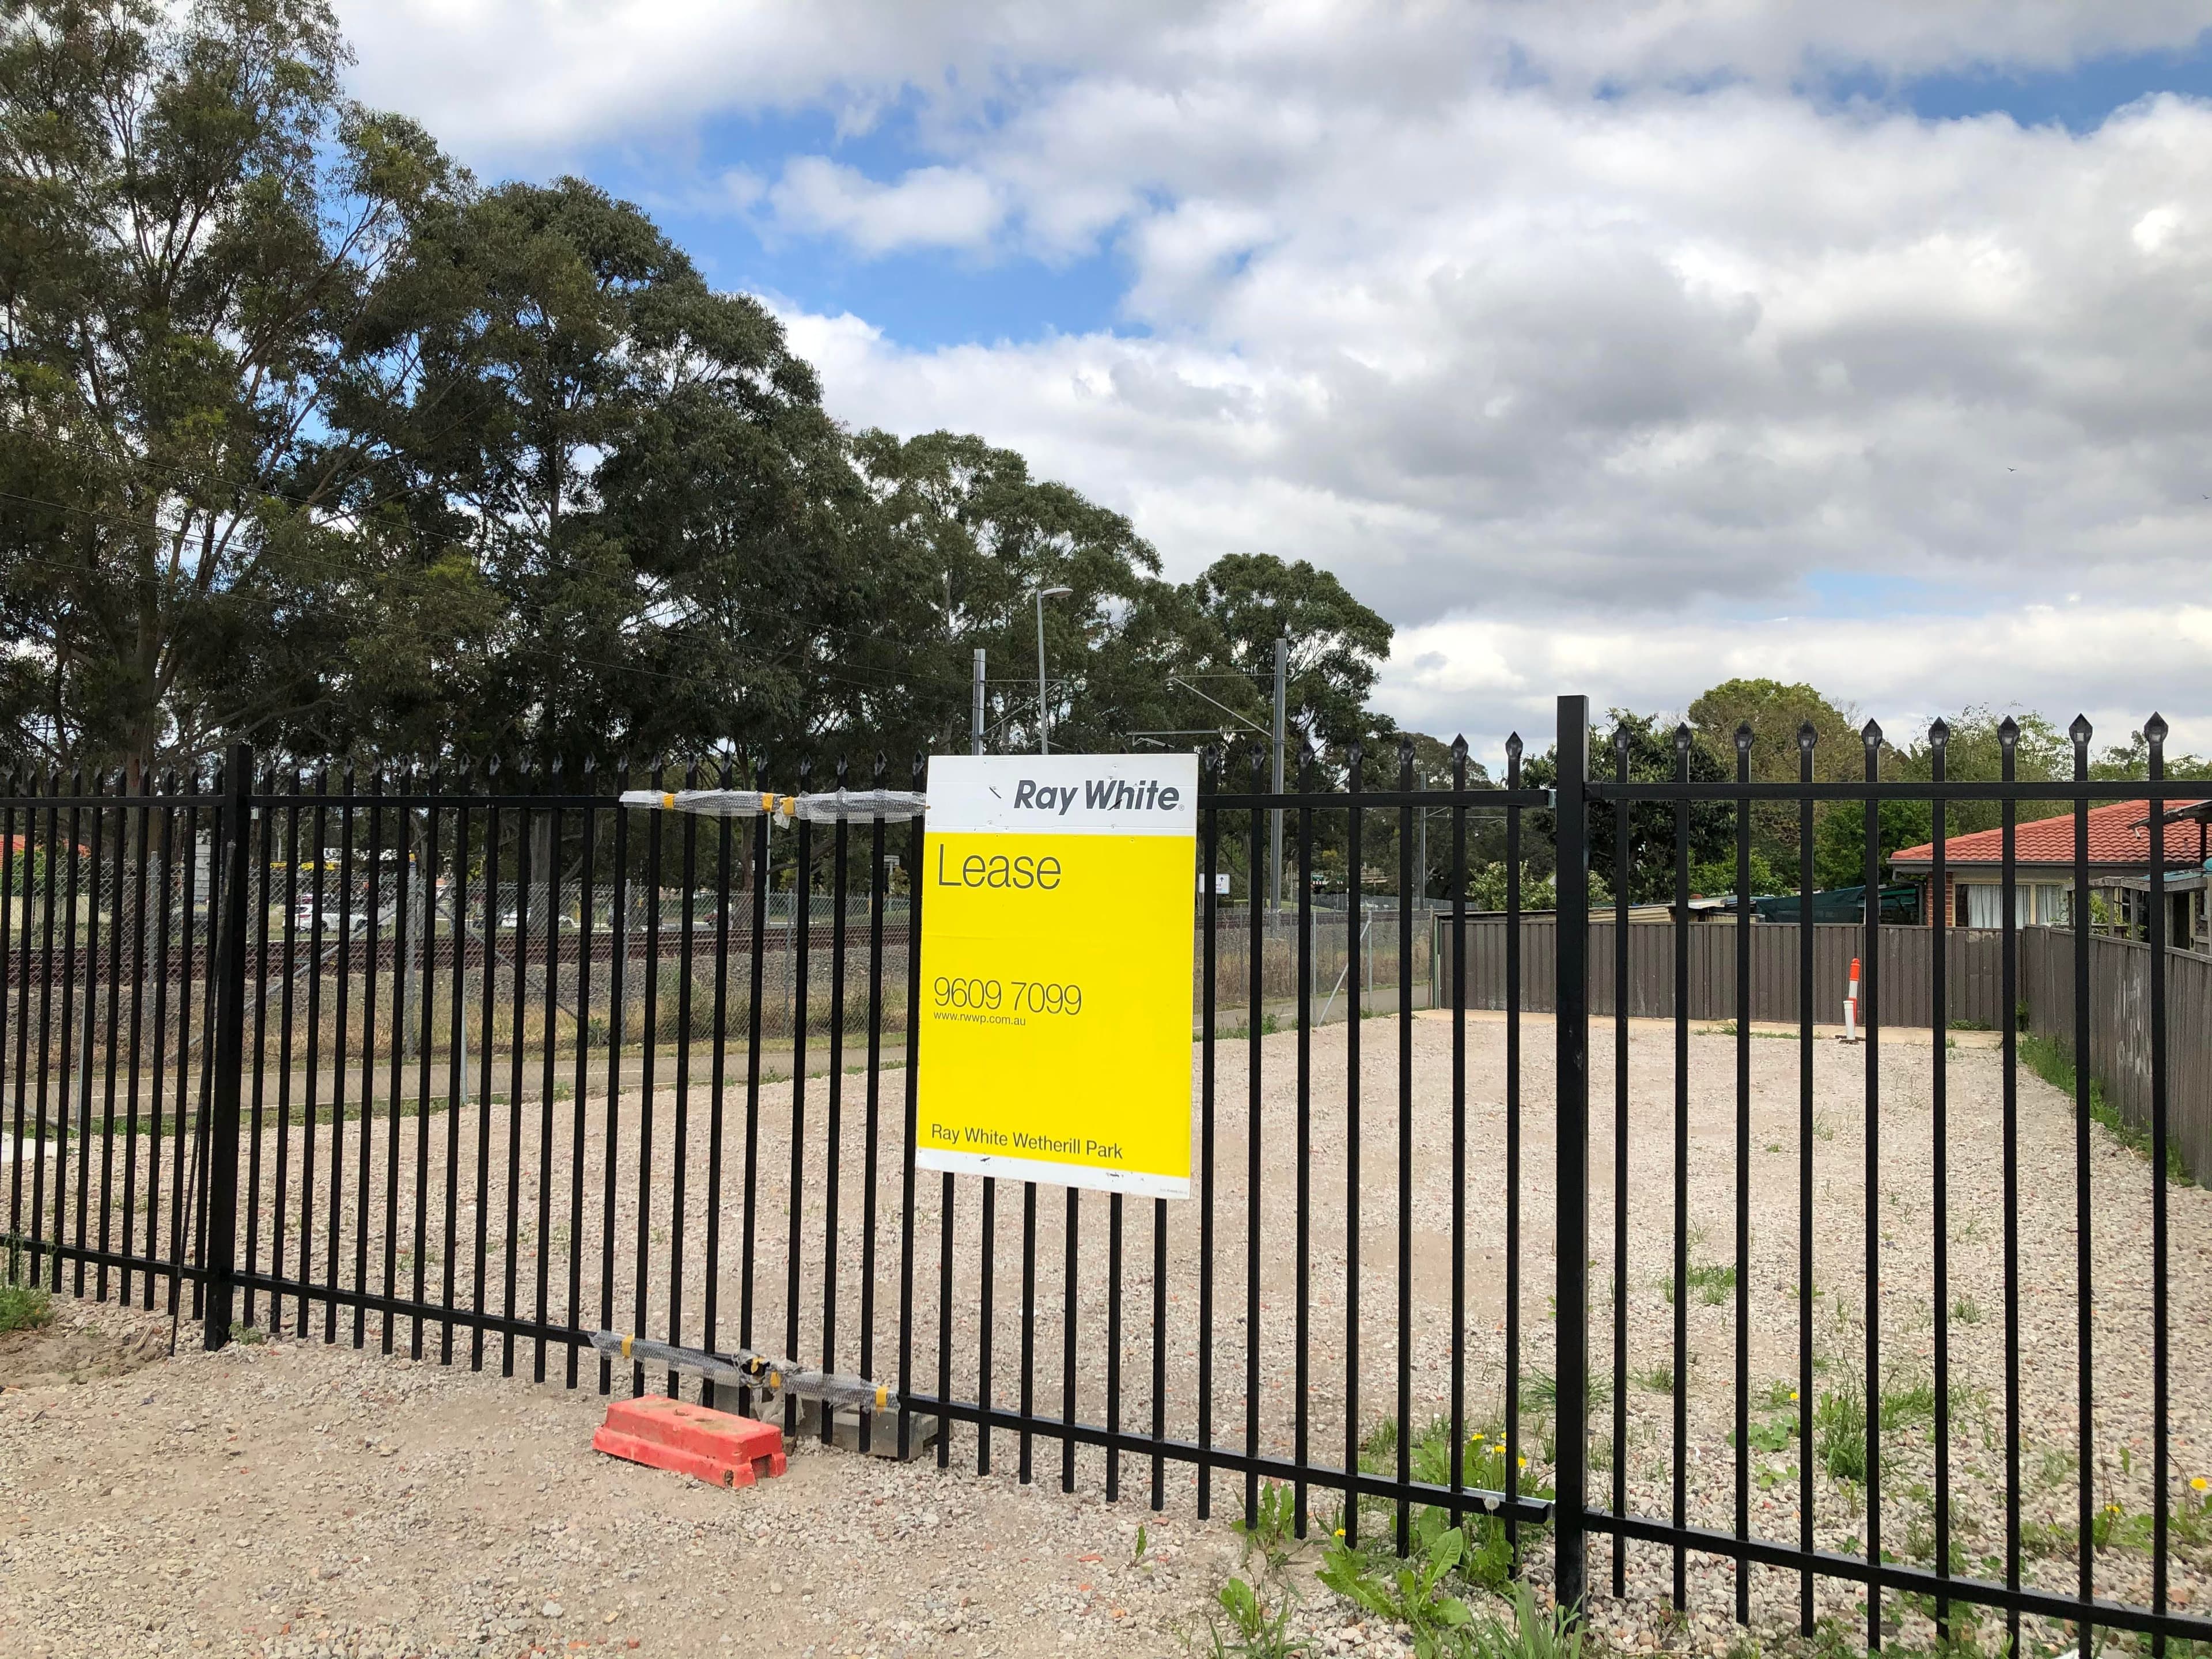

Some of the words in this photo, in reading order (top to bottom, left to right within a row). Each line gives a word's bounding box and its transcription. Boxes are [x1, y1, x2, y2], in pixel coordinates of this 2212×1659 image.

[1013, 780, 1079, 816] Ray
[1085, 779, 1179, 810] White
[938, 843, 1061, 889] Lease
[934, 976, 1002, 1010] 9609
[1010, 982, 1082, 1015] 7099
[933, 1011, 1026, 1026] www.rwwp.com.au
[931, 1124, 960, 1144] Ray
[964, 1127, 1008, 1146] White
[1013, 1132, 1081, 1154] Wetherill
[1086, 1140, 1123, 1160] Park
